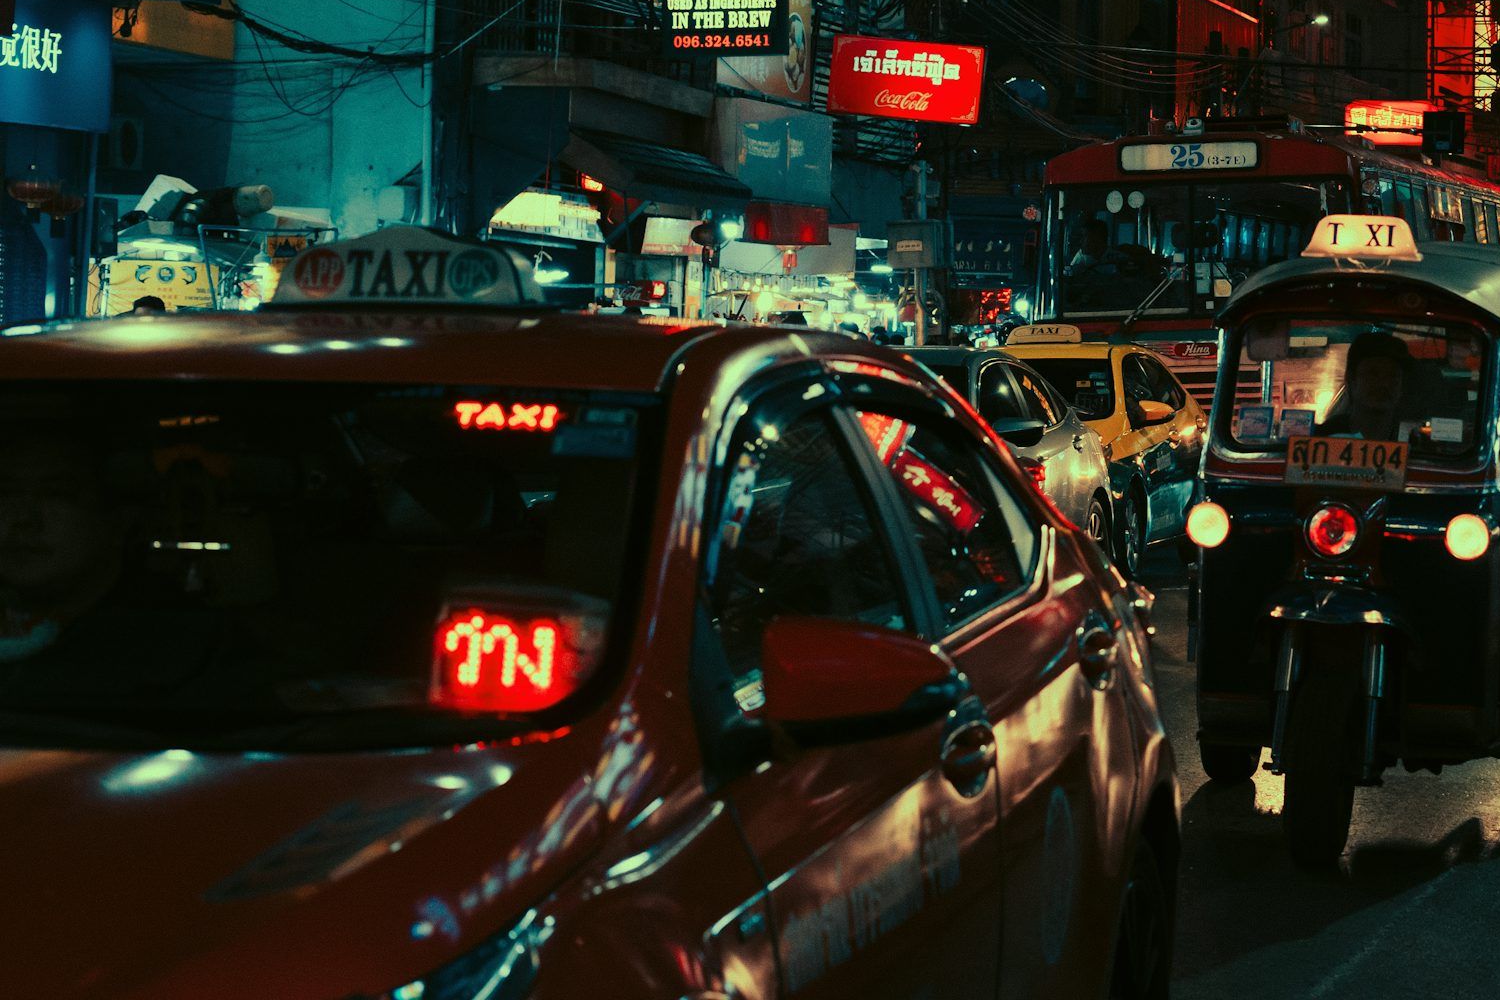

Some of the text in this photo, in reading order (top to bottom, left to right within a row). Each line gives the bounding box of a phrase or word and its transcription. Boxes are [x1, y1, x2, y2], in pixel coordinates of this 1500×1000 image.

[672, 10, 772, 29] IN THE BREW
[673, 34, 770, 49] 096.324.6541
[1171, 144, 1204, 167] 25
[1327, 222, 1396, 247] TXI
[349, 251, 449, 297] TAXI
[452, 256, 496, 290] GPS
[1030, 327, 1059, 335] TAXI
[1182, 343, 1211, 356] Hino
[455, 401, 558, 429] TAXI
[1340, 441, 1401, 469] 4104
